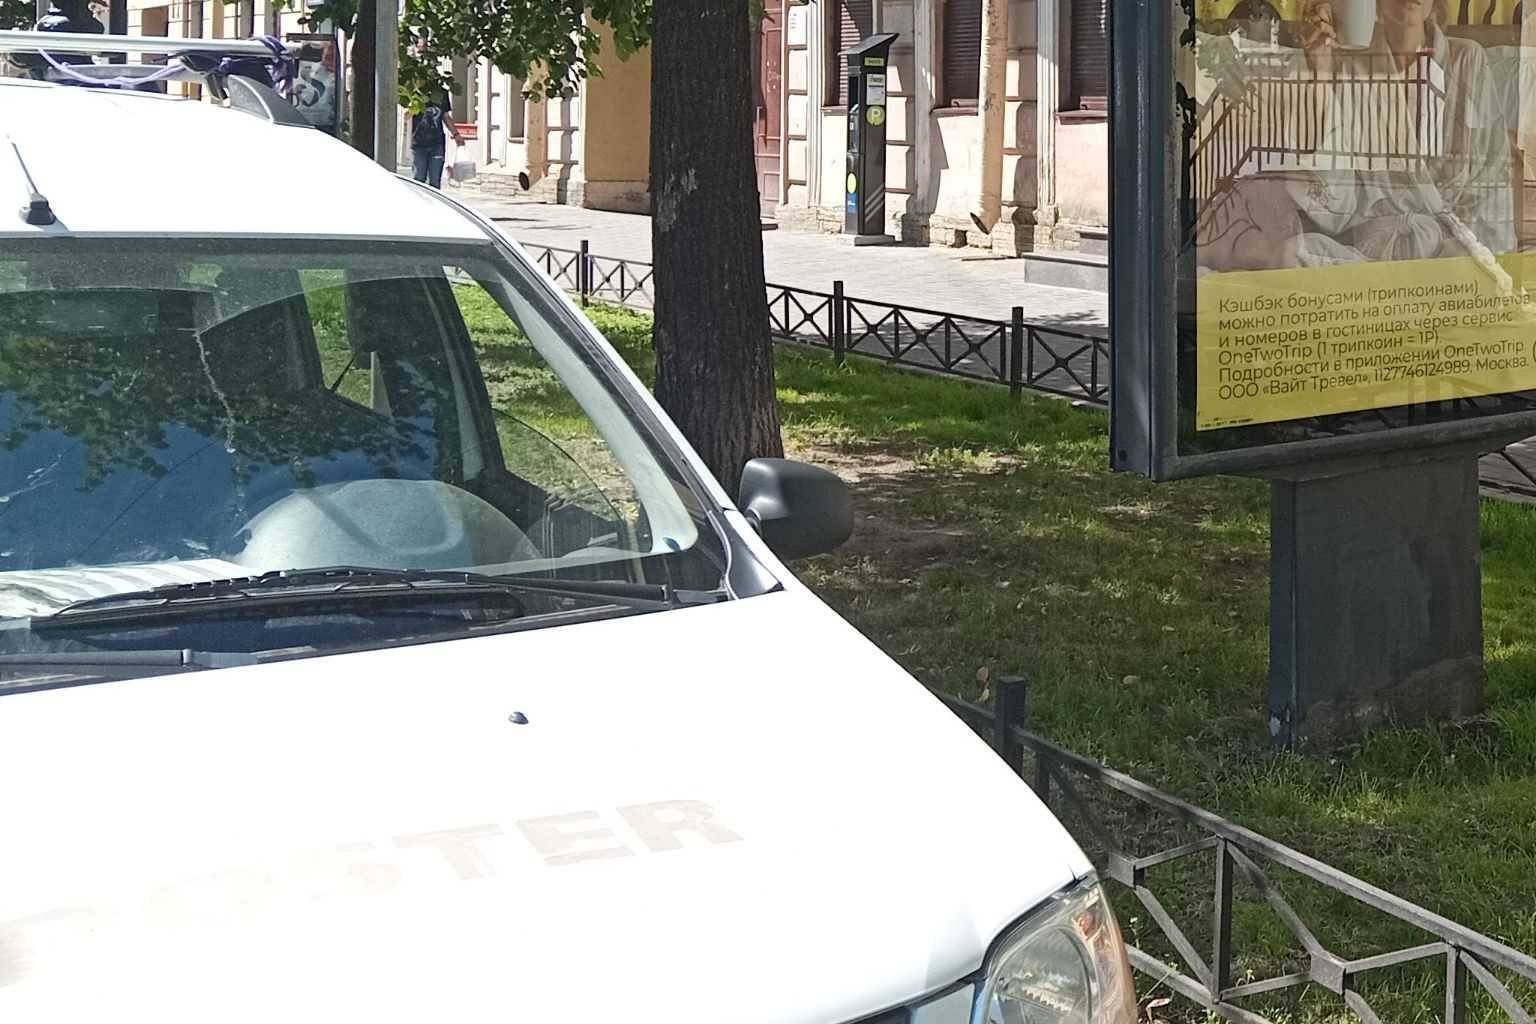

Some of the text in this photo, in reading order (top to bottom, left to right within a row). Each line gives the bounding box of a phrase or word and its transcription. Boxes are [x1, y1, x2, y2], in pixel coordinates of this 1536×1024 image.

[1219, 279, 1480, 313] Кэшбэк бонусами (трипкоинами)
[1219, 293, 1531, 331] можно потратить на оплату авиабилетов
[1218, 310, 1514, 348] и номеров в гостиницах через сервис
[1218, 344, 1313, 365] OneTwoTrip
[1330, 337, 1403, 356] трипкоин
[1219, 358, 1329, 383] Подробности
[1333, 359, 1342, 371] в
[1345, 349, 1440, 371] приложении
[1218, 382, 1259, 400] ООО
[1262, 377, 1308, 395] «Вайт
